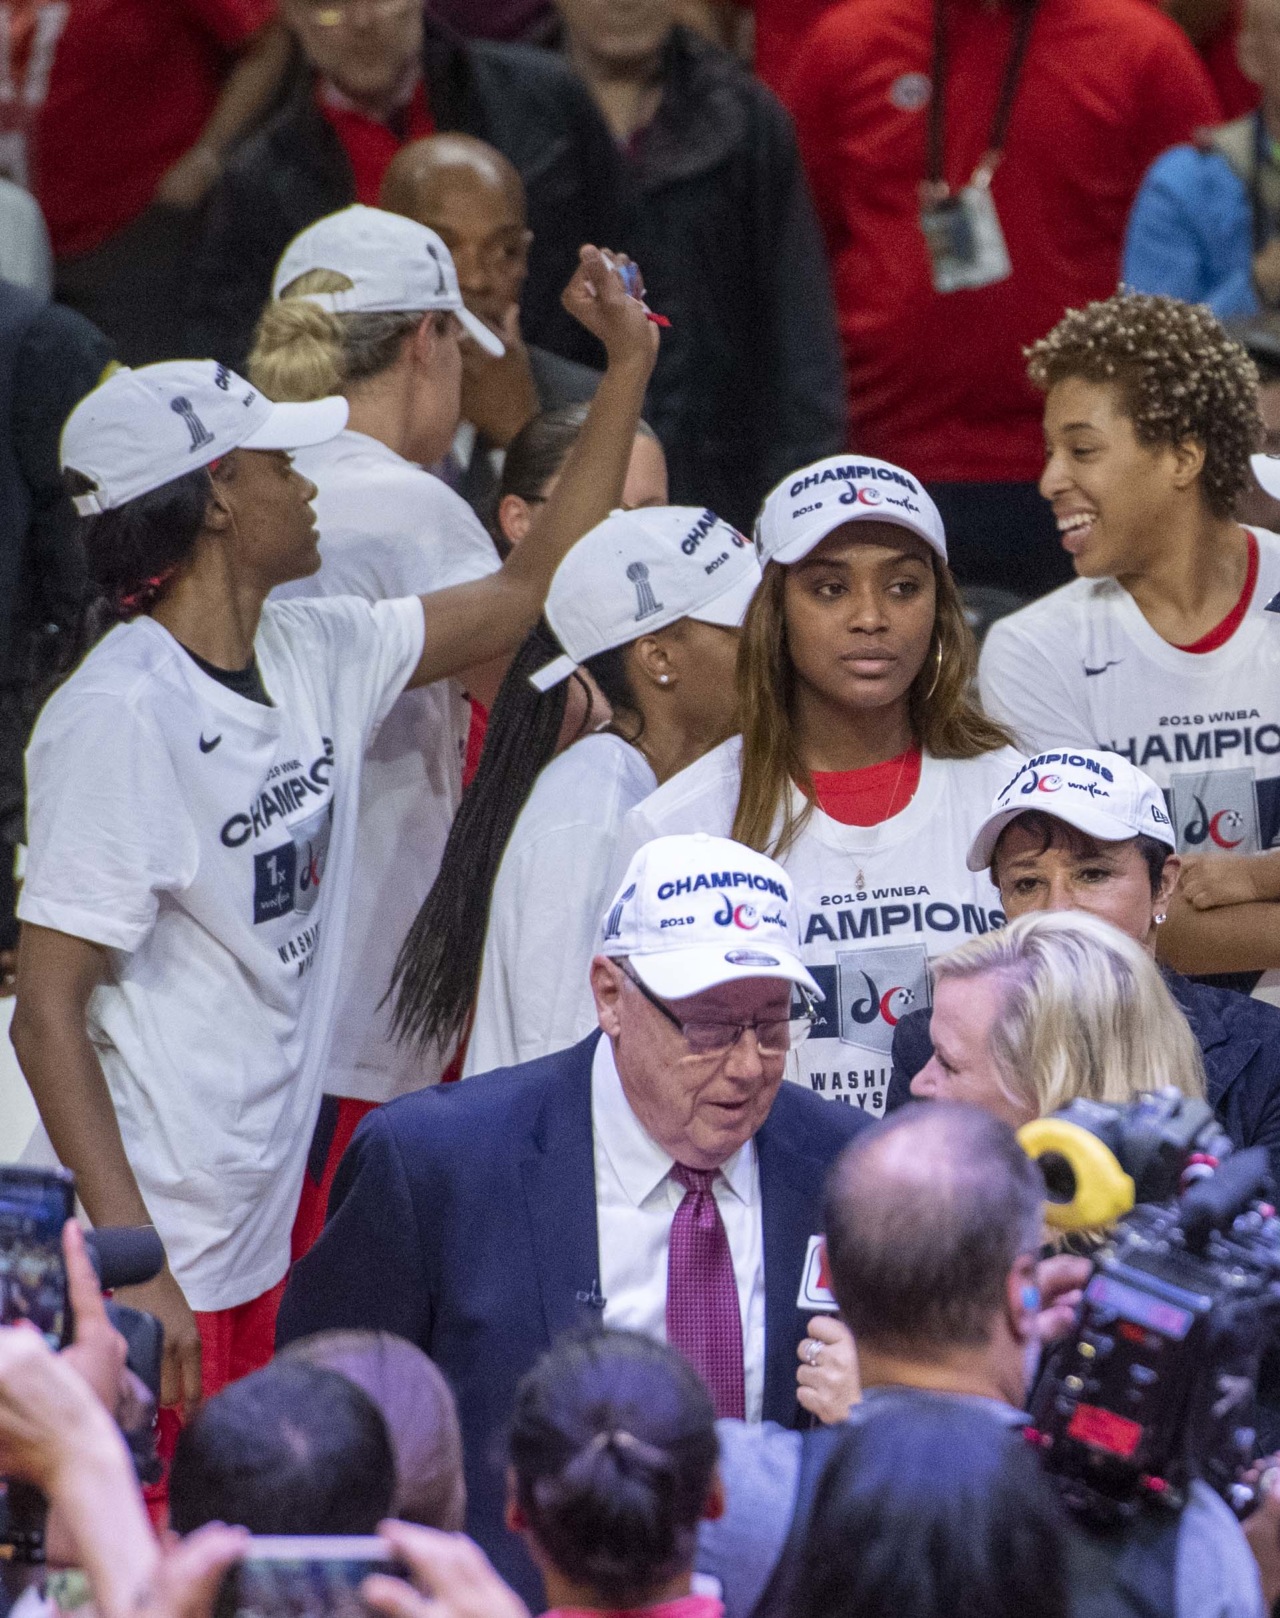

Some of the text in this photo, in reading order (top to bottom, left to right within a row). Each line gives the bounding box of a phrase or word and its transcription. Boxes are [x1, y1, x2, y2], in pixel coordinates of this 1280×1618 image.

[790, 465, 918, 498] CHAMPIONS
[792, 502, 823, 519] 2019
[1159, 709, 1260, 726] 2019 WNBA
[1067, 782, 1110, 798] WNBA
[657, 871, 789, 902] CHAMPIONS
[820, 885, 930, 906] 2019 WNBA
[660, 916, 695, 928] 2019
[810, 1067, 895, 1091] WASHI
